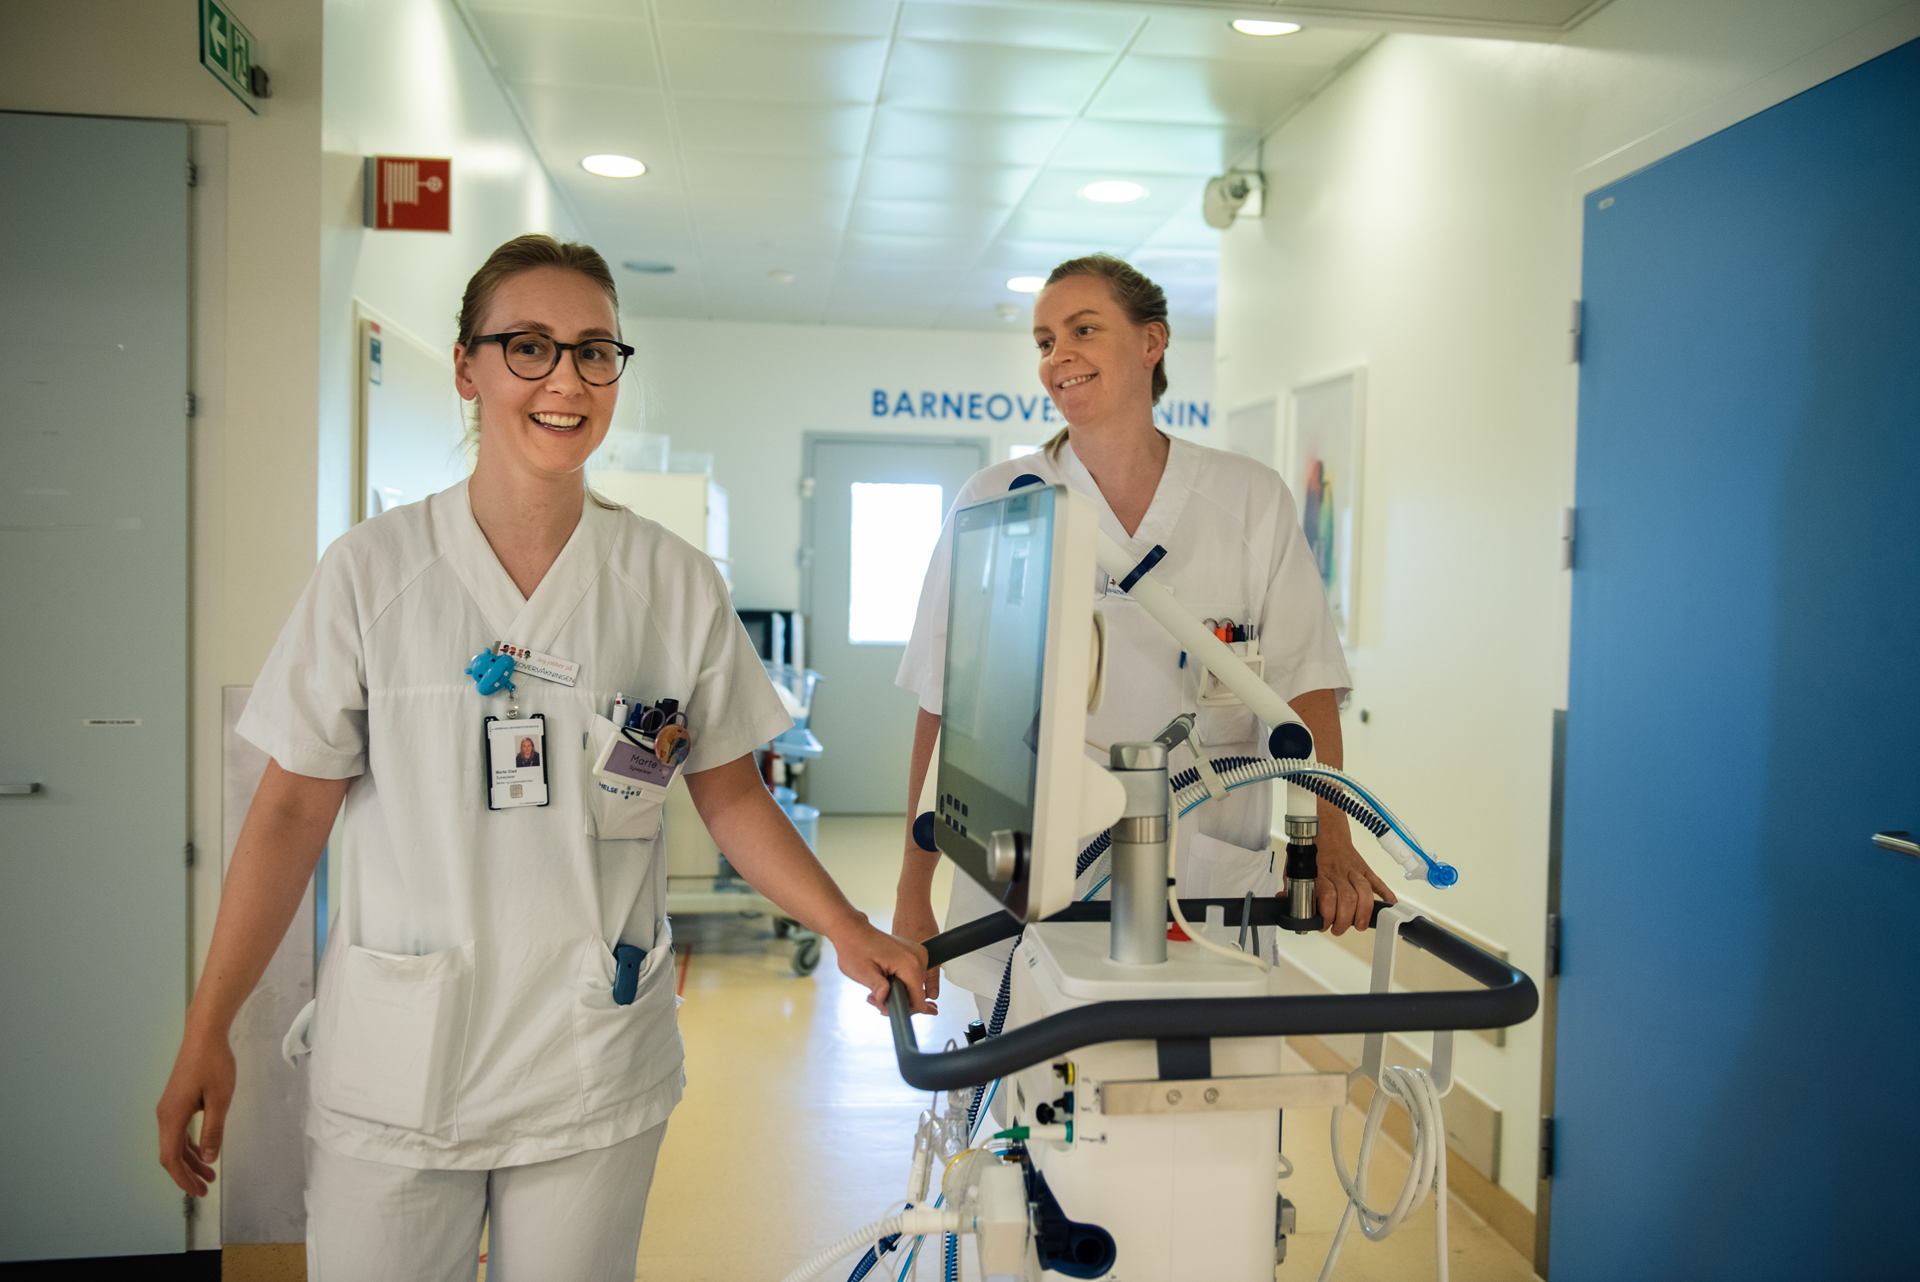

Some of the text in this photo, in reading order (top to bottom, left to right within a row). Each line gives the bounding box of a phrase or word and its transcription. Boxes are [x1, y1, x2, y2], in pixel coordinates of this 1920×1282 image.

[514, 660, 575, 683] EOVERVÅKNINGEN
[630, 754, 658, 769] Marte
[598, 781, 619, 795] HELSE
